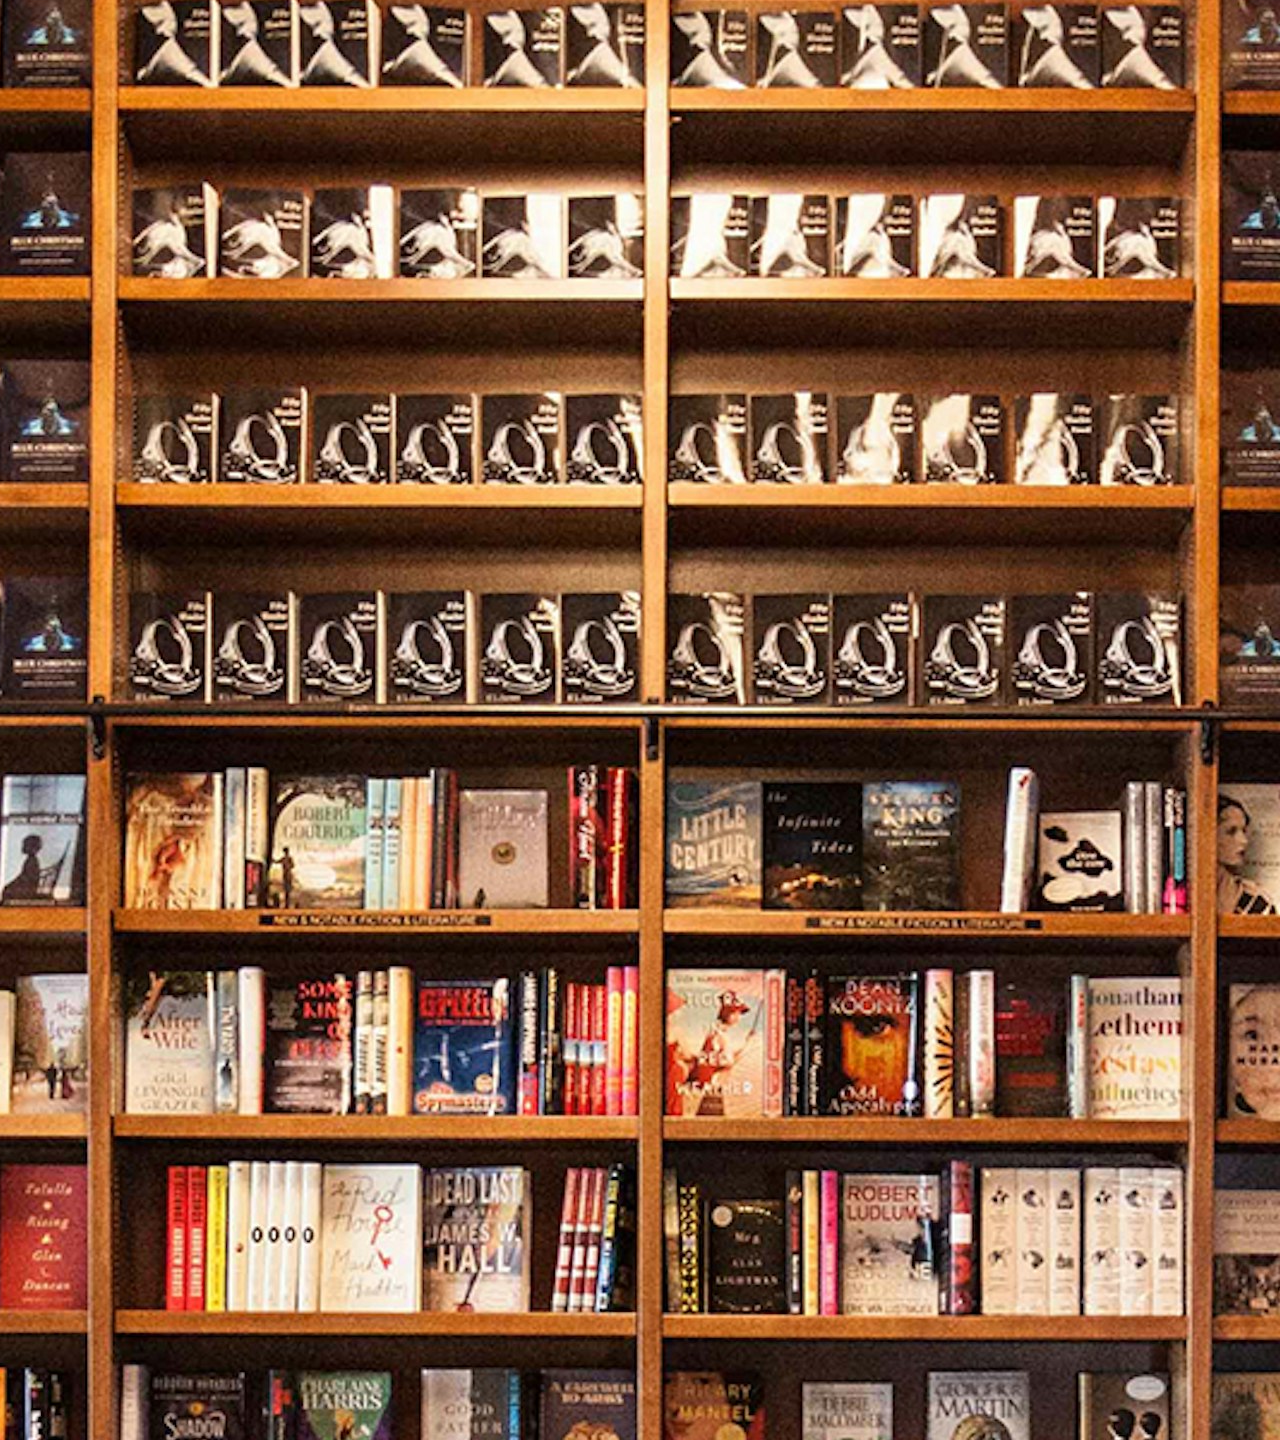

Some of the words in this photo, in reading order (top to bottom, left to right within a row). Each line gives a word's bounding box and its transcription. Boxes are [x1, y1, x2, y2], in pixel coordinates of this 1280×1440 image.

[680, 806, 747, 838] LITTLE
[778, 817, 841, 829] Infinite
[882, 808, 942, 826] KING
[671, 837, 756, 871] CENTURY
[812, 842, 854, 854] Tides
[845, 982, 901, 996] DEAN
[830, 997, 914, 1015] KOONTZ
[153, 1012, 201, 1030] After
[153, 1031, 199, 1049] Wife
[154, 1073, 188, 1085] GIGI
[417, 1093, 504, 1111] Spymasters
[353, 1174, 405, 1207] Red
[431, 1172, 471, 1206] DEAD
[475, 1172, 520, 1206] LAST
[847, 1185, 933, 1202] ROBERT
[425, 1225, 489, 1245] JAMES
[438, 1245, 510, 1274] HALL
[301, 1379, 383, 1396] CHARLAINE
[684, 1384, 751, 1398] HILARY
[301, 1393, 382, 1411] HARRIS
[444, 1405, 494, 1417] GOOD
[935, 1398, 1025, 1418] MARTIN
[678, 1406, 753, 1422] MANTEL
[165, 1408, 225, 1440] SHADOW
